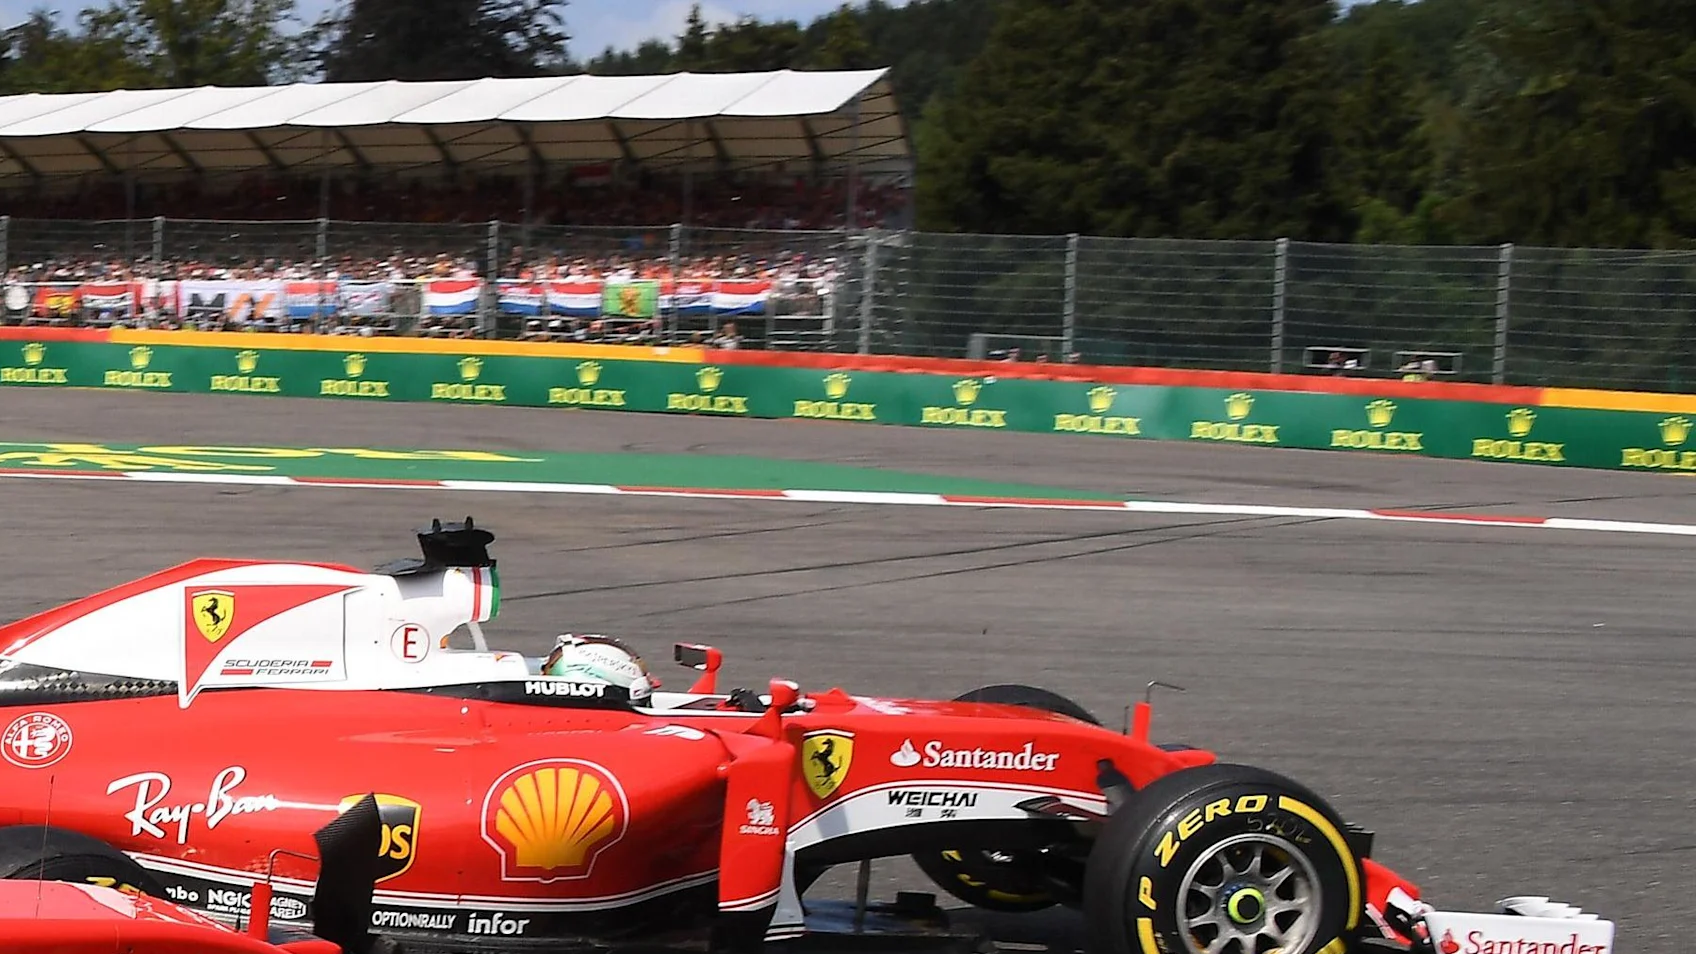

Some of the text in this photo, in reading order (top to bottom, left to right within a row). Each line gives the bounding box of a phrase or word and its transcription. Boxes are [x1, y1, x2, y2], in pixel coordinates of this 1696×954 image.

[0, 367, 67, 384] ROLEX
[104, 370, 172, 388] ROLEX
[211, 375, 281, 393] ROLEX
[321, 380, 390, 398] ROLEX
[431, 383, 506, 401] ROLEX
[548, 387, 626, 407] ROLEX
[667, 393, 749, 414] ROLEX
[794, 400, 877, 421] ROLEX
[921, 406, 1007, 428] ROLEX
[1054, 413, 1141, 435] ROLEX
[1191, 420, 1280, 444] ROLEX
[1331, 428, 1423, 451] ROLEX
[1472, 438, 1565, 462] ROLEX
[1620, 447, 1696, 470] ROLE
[403, 627, 418, 659] E
[223, 659, 309, 667] SCUDERIA
[256, 668, 329, 676] FERRARI
[525, 681, 607, 698] HUBLOT
[923, 740, 1060, 772] Santander
[888, 790, 978, 808] WEICHAI
[1154, 795, 1268, 867] ZERO
[207, 889, 252, 908] NGK
[467, 912, 531, 934] infor
